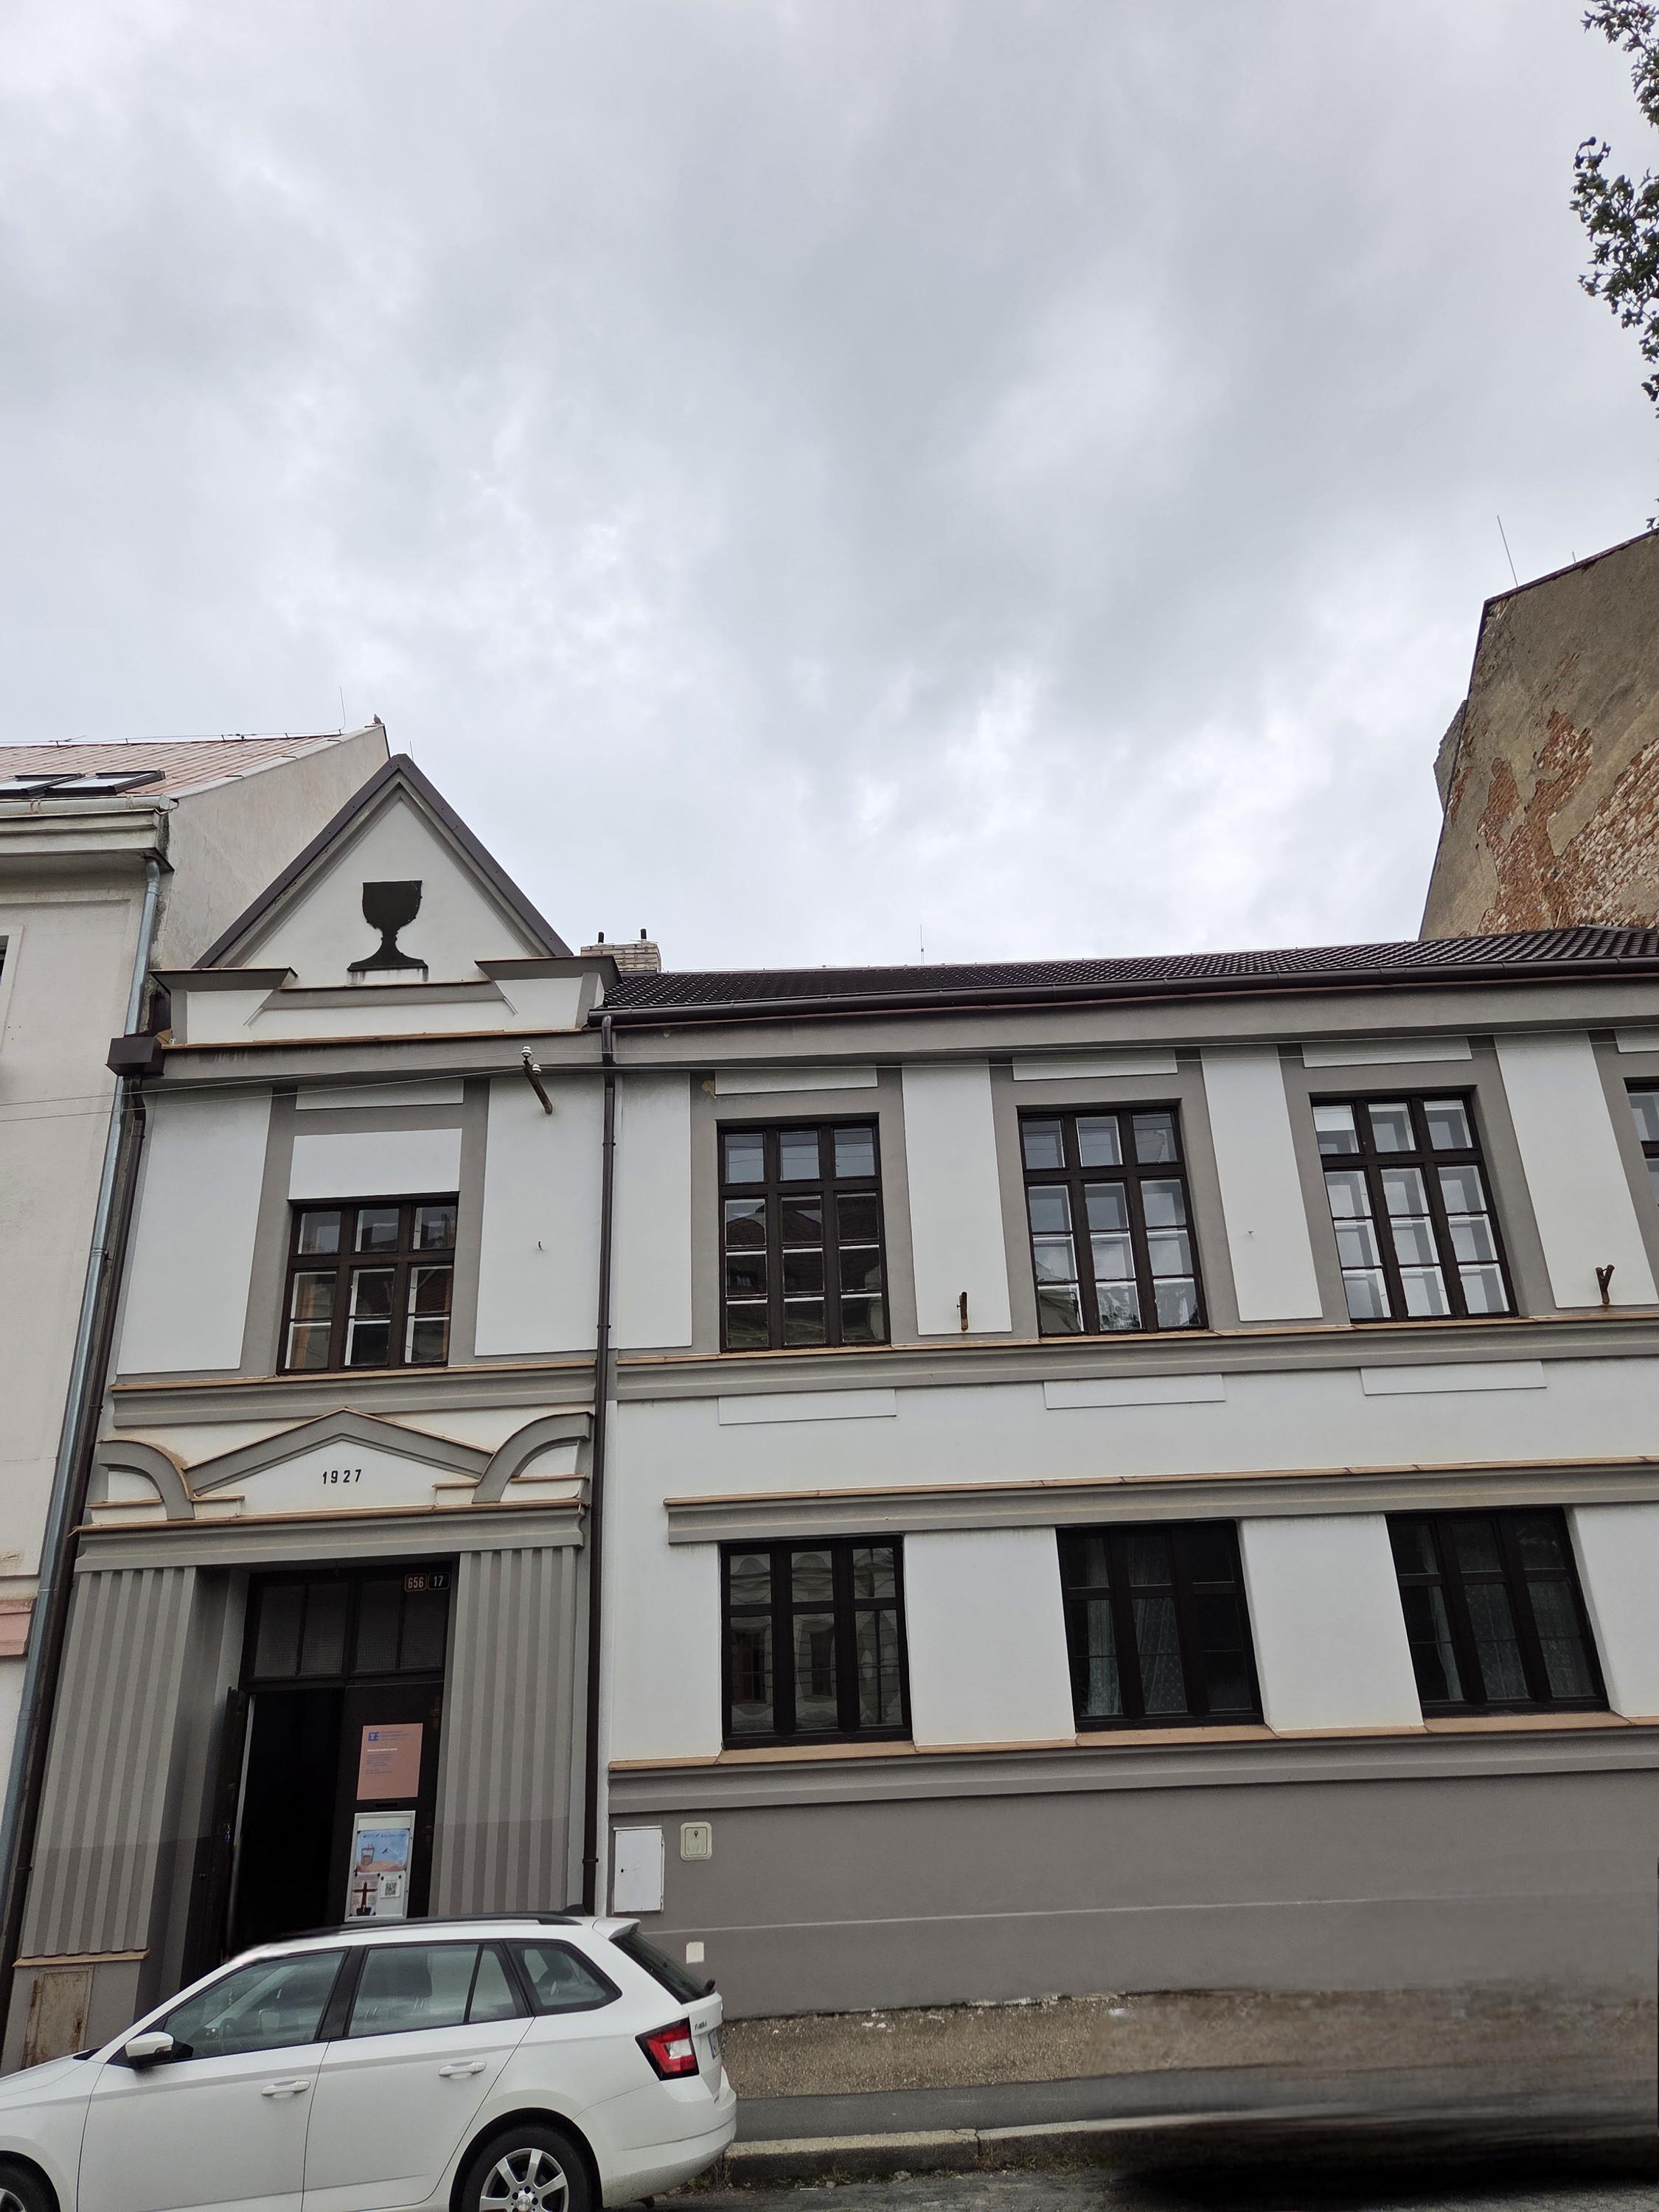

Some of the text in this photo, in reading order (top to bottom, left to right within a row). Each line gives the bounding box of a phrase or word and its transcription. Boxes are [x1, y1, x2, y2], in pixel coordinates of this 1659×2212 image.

[322, 1469, 362, 1484] 1927
[408, 1576, 424, 1588] 656
[433, 1575, 444, 1587] 17
